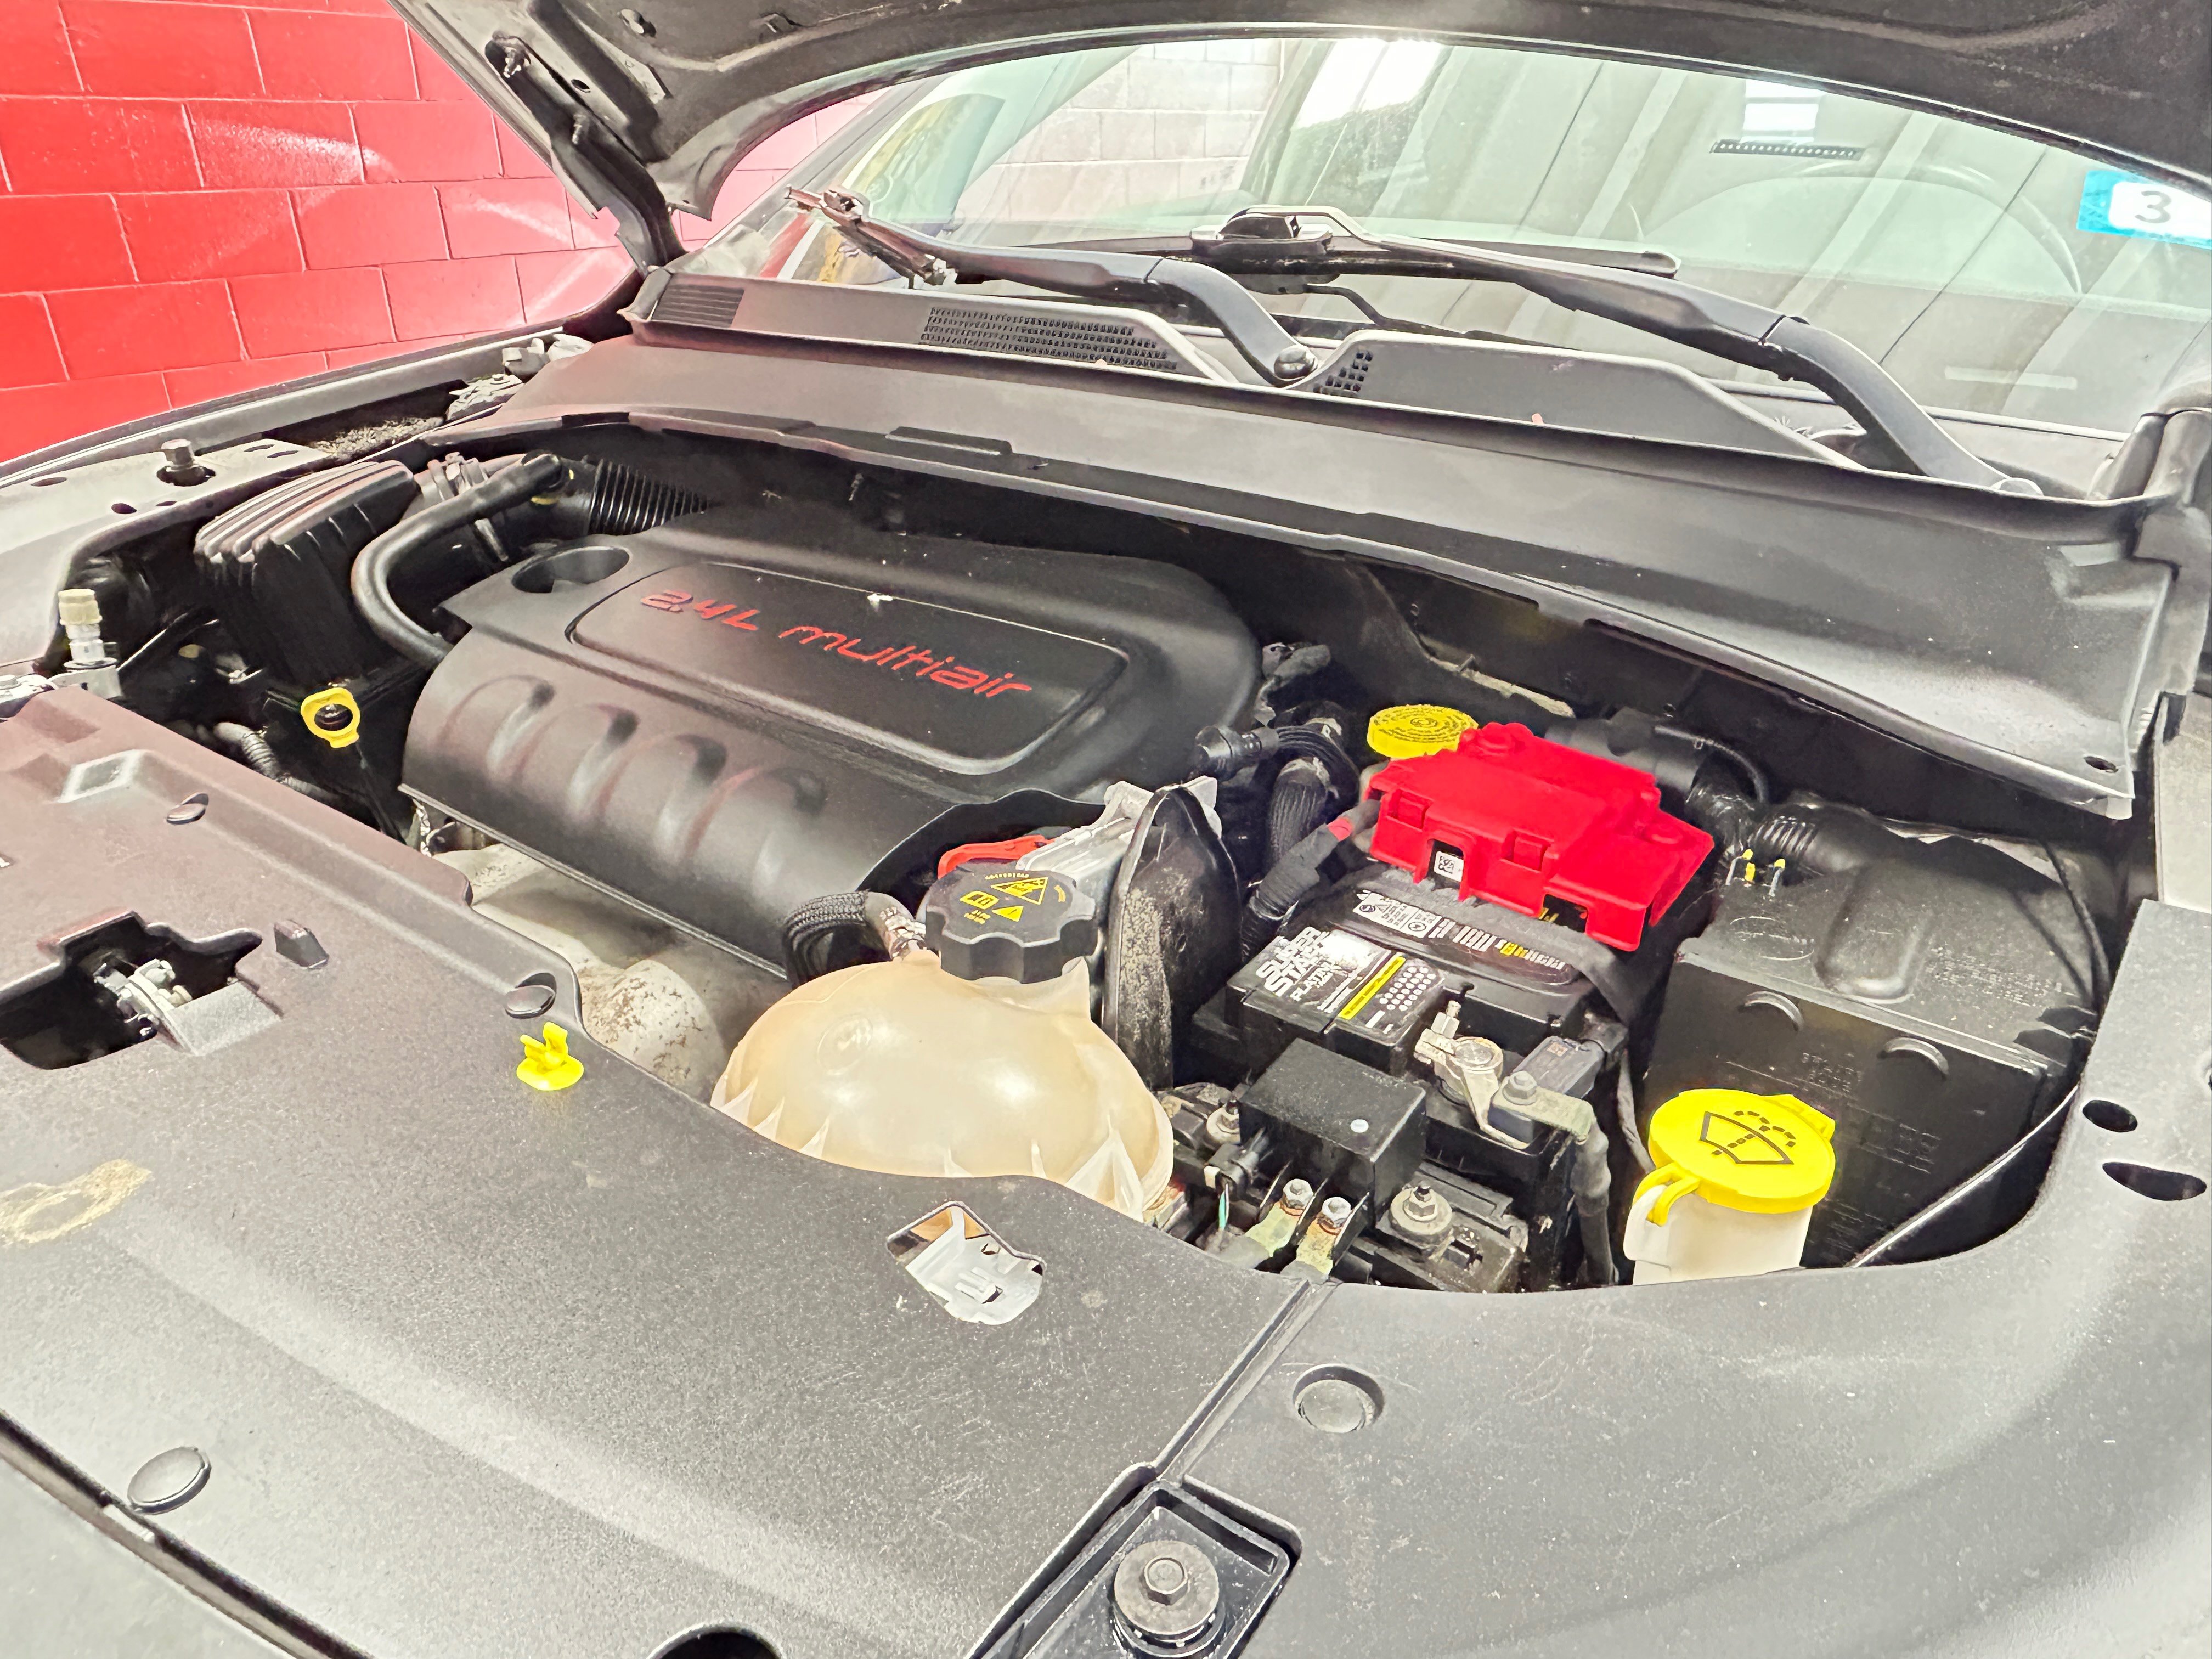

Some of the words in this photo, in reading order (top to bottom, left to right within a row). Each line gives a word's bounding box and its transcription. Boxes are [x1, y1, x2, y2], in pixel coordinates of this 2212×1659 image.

[2135, 190, 2172, 224] 3
[778, 625, 1032, 697] multiair
[1255, 926, 1322, 978] SUPER
